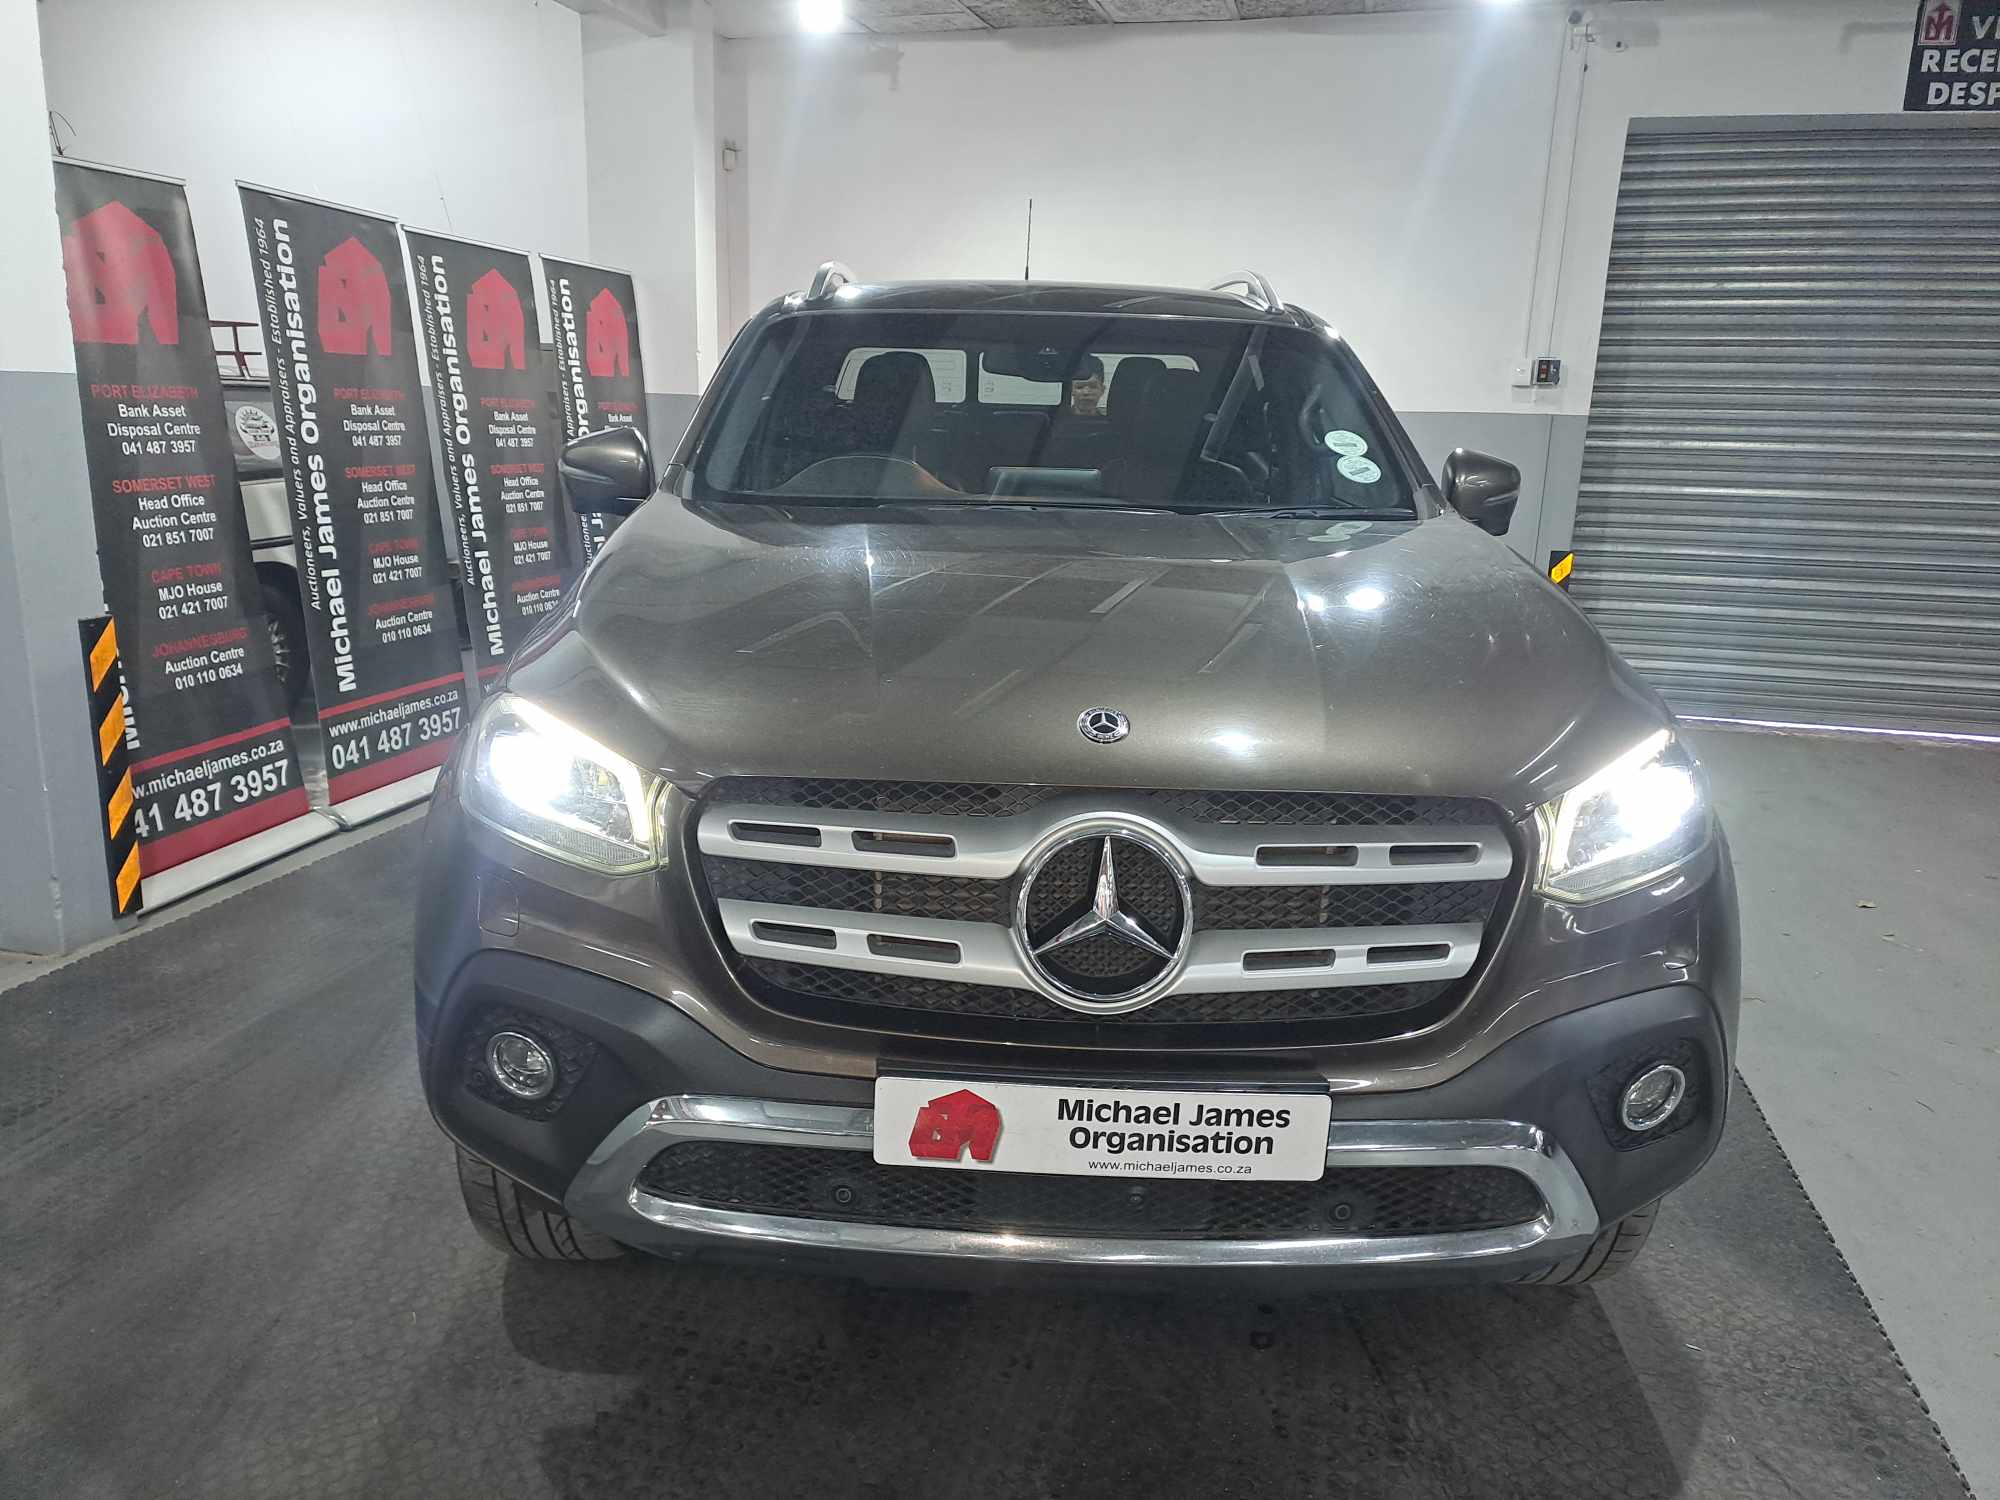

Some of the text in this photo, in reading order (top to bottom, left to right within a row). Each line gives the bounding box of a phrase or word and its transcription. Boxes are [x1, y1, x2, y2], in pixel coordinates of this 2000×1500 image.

[254, 216, 269, 255] 1964
[259, 257, 282, 345] Established
[422, 288, 440, 361] Established
[431, 255, 471, 445] Organisation
[90, 384, 129, 399] PORT
[277, 357, 296, 434] Appraisers
[435, 371, 453, 436] Appraisers
[118, 403, 187, 418] Bank Asset
[350, 404, 396, 416] Bank Asset
[107, 422, 201, 439] Disposal Centre
[343, 420, 406, 433] Disposal Centre
[122, 440, 196, 456] 041 487 3957
[286, 436, 300, 465] and
[352, 434, 402, 447] 041 487 3957
[444, 437, 456, 463] and
[273, 218, 357, 692] Michael James Organisation
[112, 474, 217, 494] SOMERSET WEST
[293, 468, 308, 520] Valuers
[361, 480, 407, 493] Head Office
[450, 465, 463, 509] Valuers
[501, 490, 524, 501] Auction
[138, 493, 206, 511] Head Office
[357, 495, 415, 509] Auction Centre
[462, 453, 487, 543] James
[132, 511, 217, 531] Auction Centre
[363, 509, 414, 524] 021 851 7007
[142, 527, 214, 548] 021 851 7007
[458, 513, 476, 586] Auctioneers,
[528, 540, 548, 550] House
[580, 513, 594, 565] uctionee
[302, 525, 321, 610] Auctioneers,
[372, 554, 420, 569] MJO House
[151, 567, 184, 583] CAPE
[372, 566, 422, 584] 021 421 7007
[158, 581, 223, 602] MJO House
[474, 550, 505, 656] Michael
[158, 596, 228, 620] 021 421 7007
[375, 610, 433, 630] Auction Centre
[382, 622, 432, 643] 010 110 0634
[165, 647, 245, 675] Auction Centre
[174, 662, 244, 691] 010 110 0634
[329, 688, 459, 738] www.michaeljames.co.za
[331, 706, 461, 770] 041 487 3957
[132, 739, 284, 800] w.michaeljames.co.za
[134, 759, 289, 837] 41 487 3957
[1057, 1098, 1291, 1128] Michael James
[1069, 1126, 1274, 1155] Organisation
[1088, 1160, 1252, 1175] www.michaeljames.co.za
